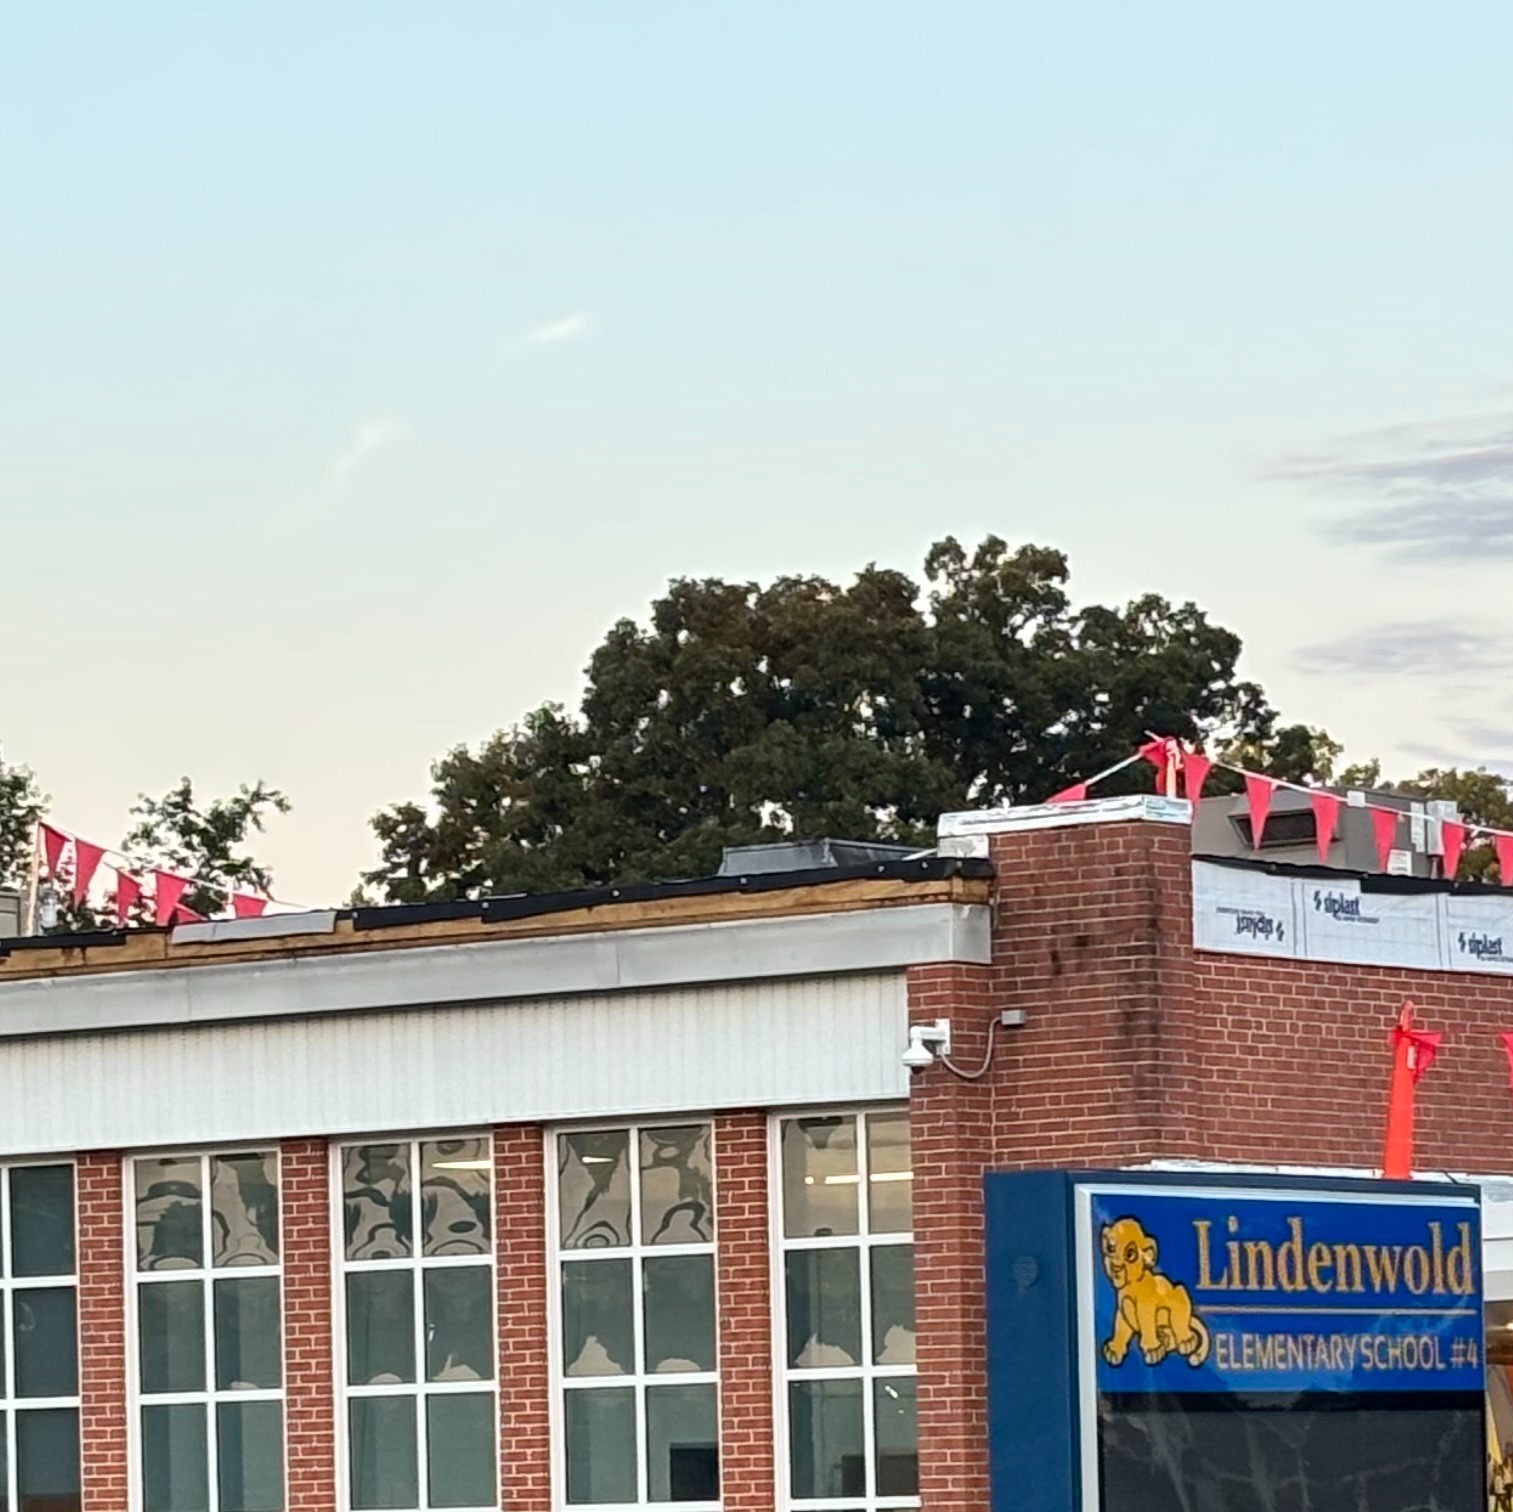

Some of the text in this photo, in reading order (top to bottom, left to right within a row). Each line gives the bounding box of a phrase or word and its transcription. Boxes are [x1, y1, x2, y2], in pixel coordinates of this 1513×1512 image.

[1192, 1215, 1475, 1295] Lindenwold
[1214, 1332, 1478, 1371] ELEMENTARY SCHOOL #4
